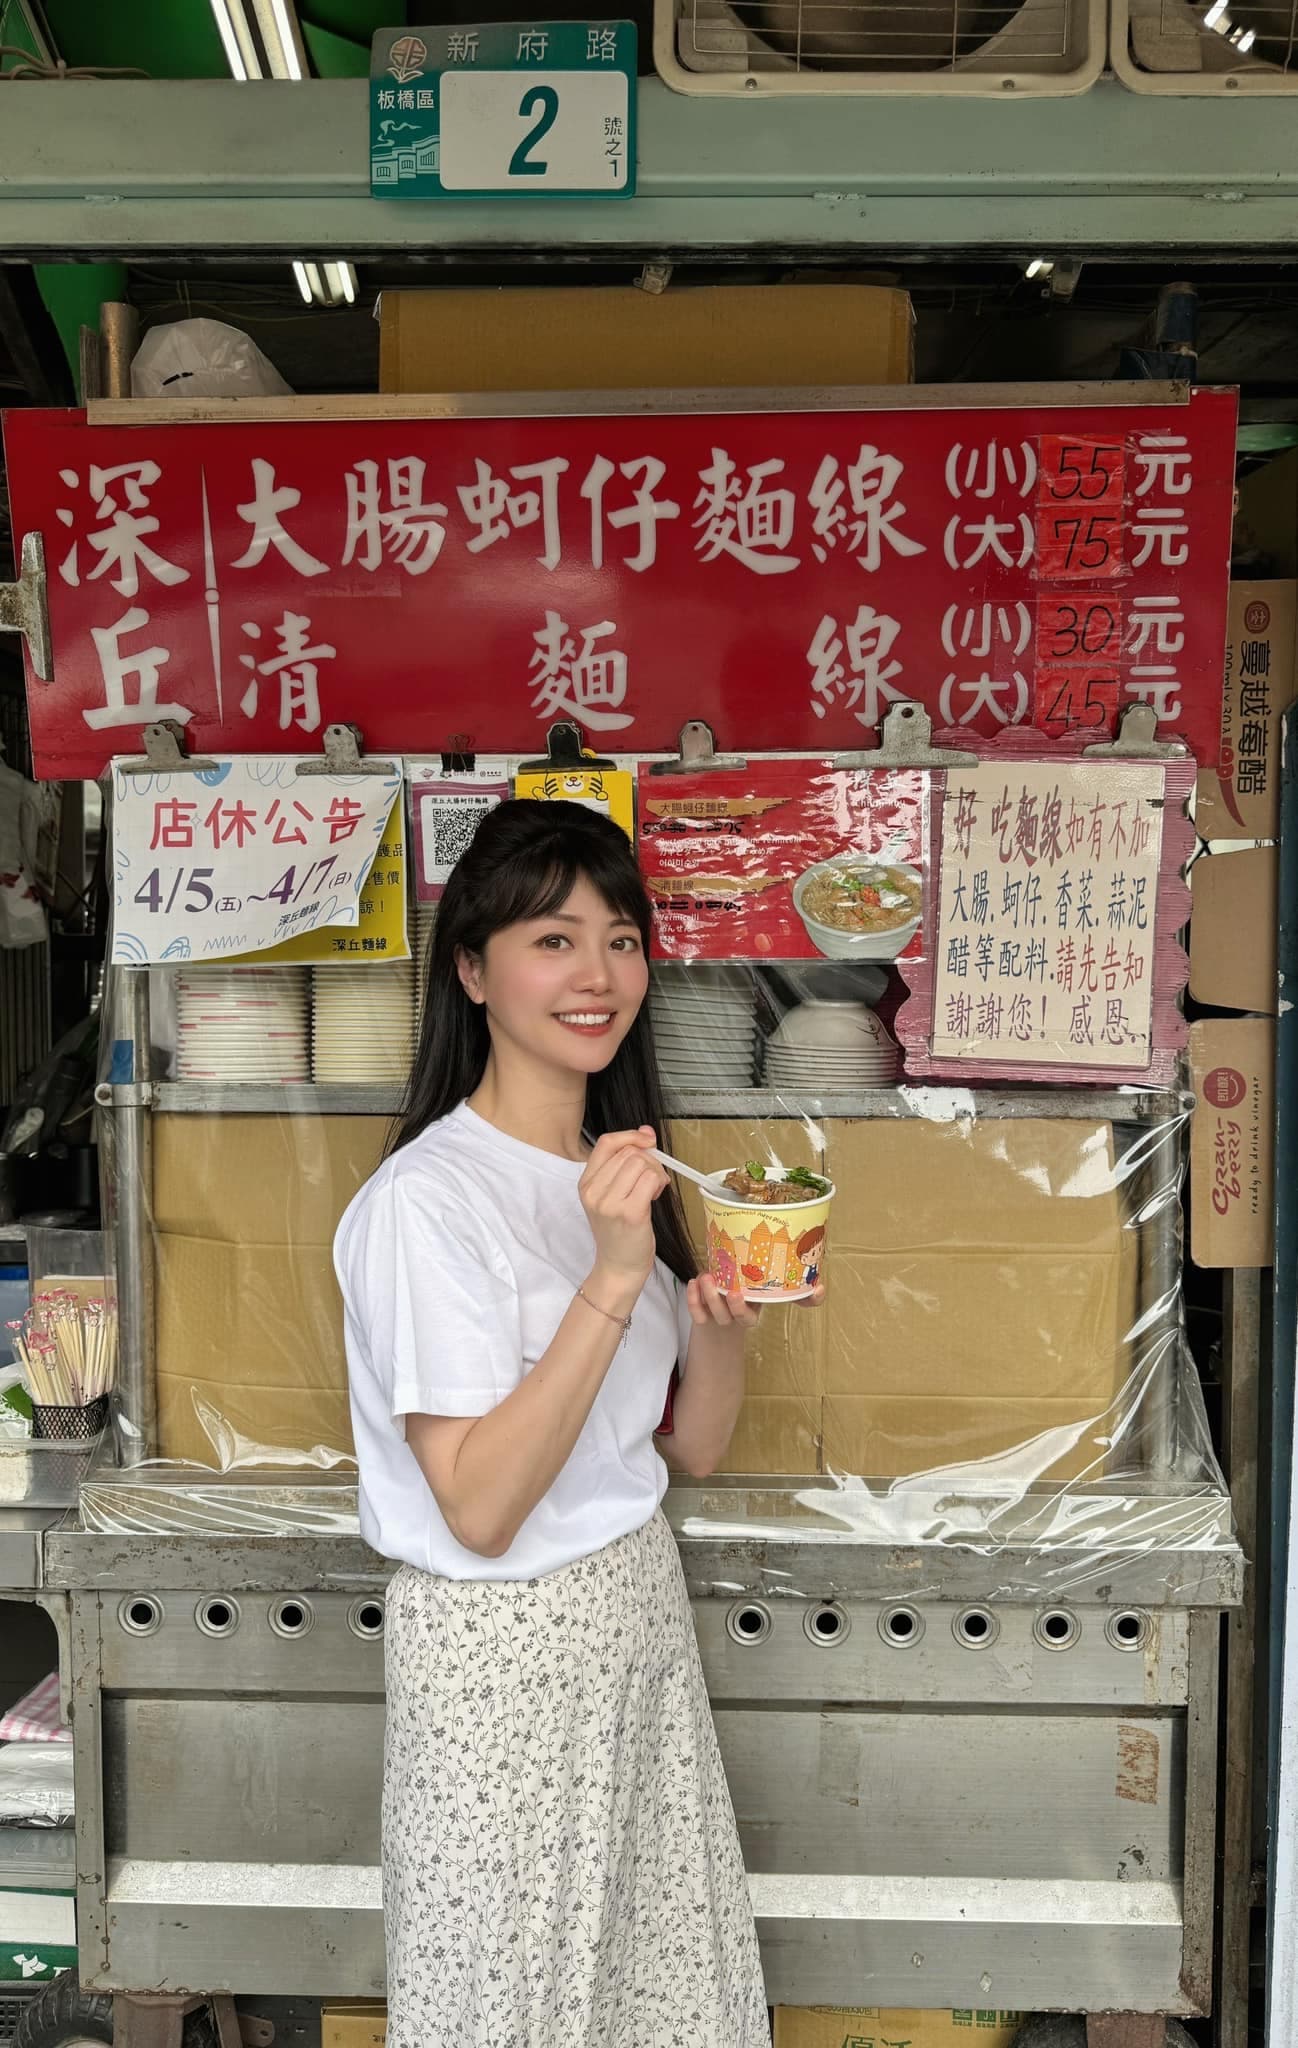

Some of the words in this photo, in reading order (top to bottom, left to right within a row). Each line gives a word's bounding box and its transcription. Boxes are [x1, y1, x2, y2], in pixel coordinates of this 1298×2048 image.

[447, 28, 617, 62] 新府路
[377, 89, 435, 110] 板橋區
[508, 85, 559, 176] 2
[604, 117, 623, 178] 號之1
[229, 444, 926, 577] 大腸蚵仔麵線
[56, 459, 196, 732] 深丘
[150, 797, 366, 850] 店休公告
[366, 870, 400, 887] 售價
[332, 937, 387, 952] 深丘麵線
[1251, 1075, 1263, 1121] vinegar
[1250, 1126, 1259, 1160] drink
[1211, 1116, 1229, 1216] Cran-
[1250, 1164, 1259, 1174] to
[1249, 1178, 1262, 1215] ready
